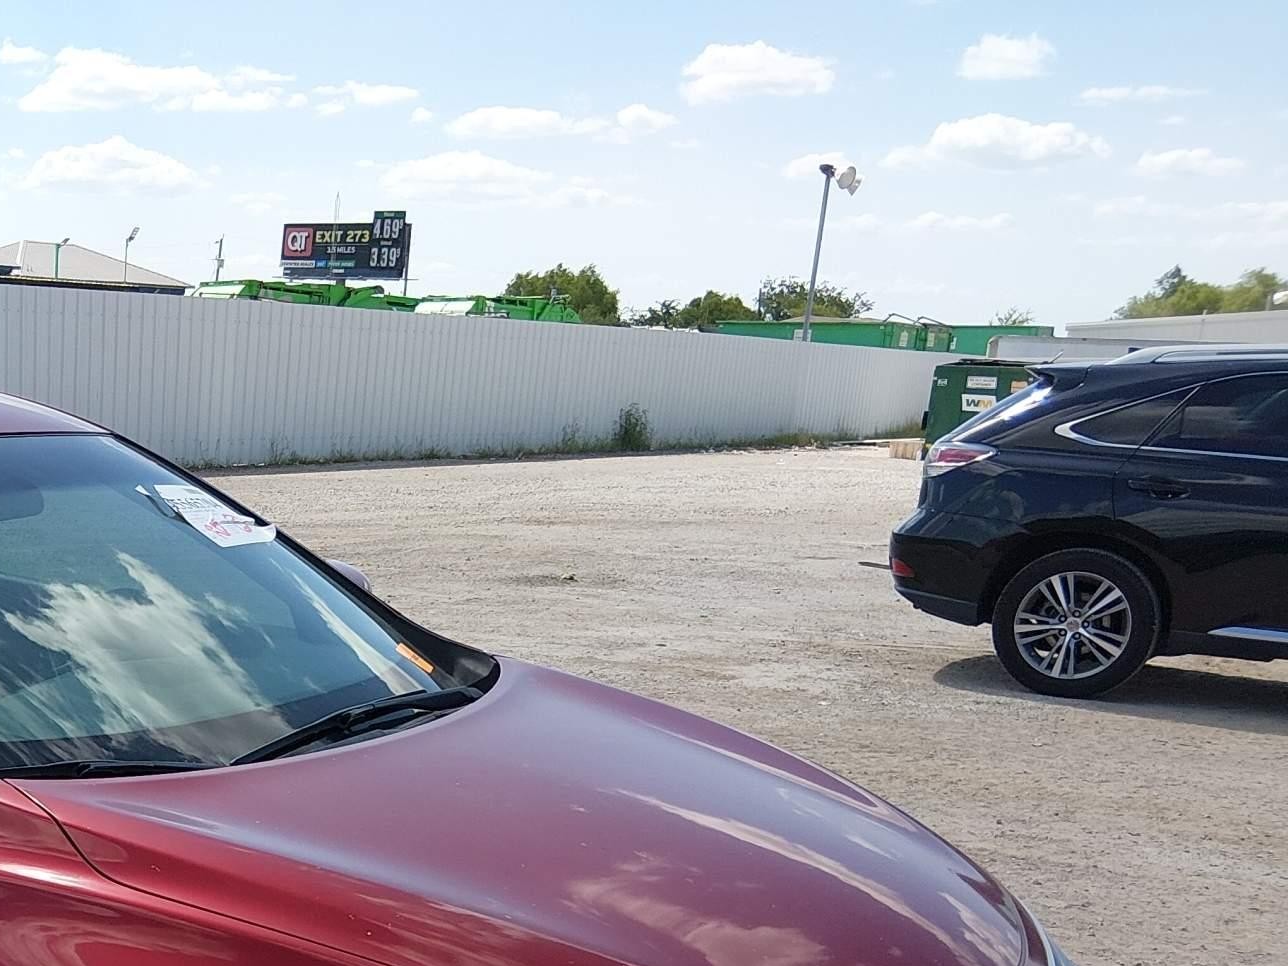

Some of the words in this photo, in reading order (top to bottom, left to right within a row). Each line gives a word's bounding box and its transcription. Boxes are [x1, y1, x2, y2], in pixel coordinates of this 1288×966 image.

[287, 231, 309, 252] QT
[315, 230, 344, 243] EXIT
[346, 230, 370, 243] 273
[337, 246, 356, 254] MILES
[965, 398, 993, 408] WM
